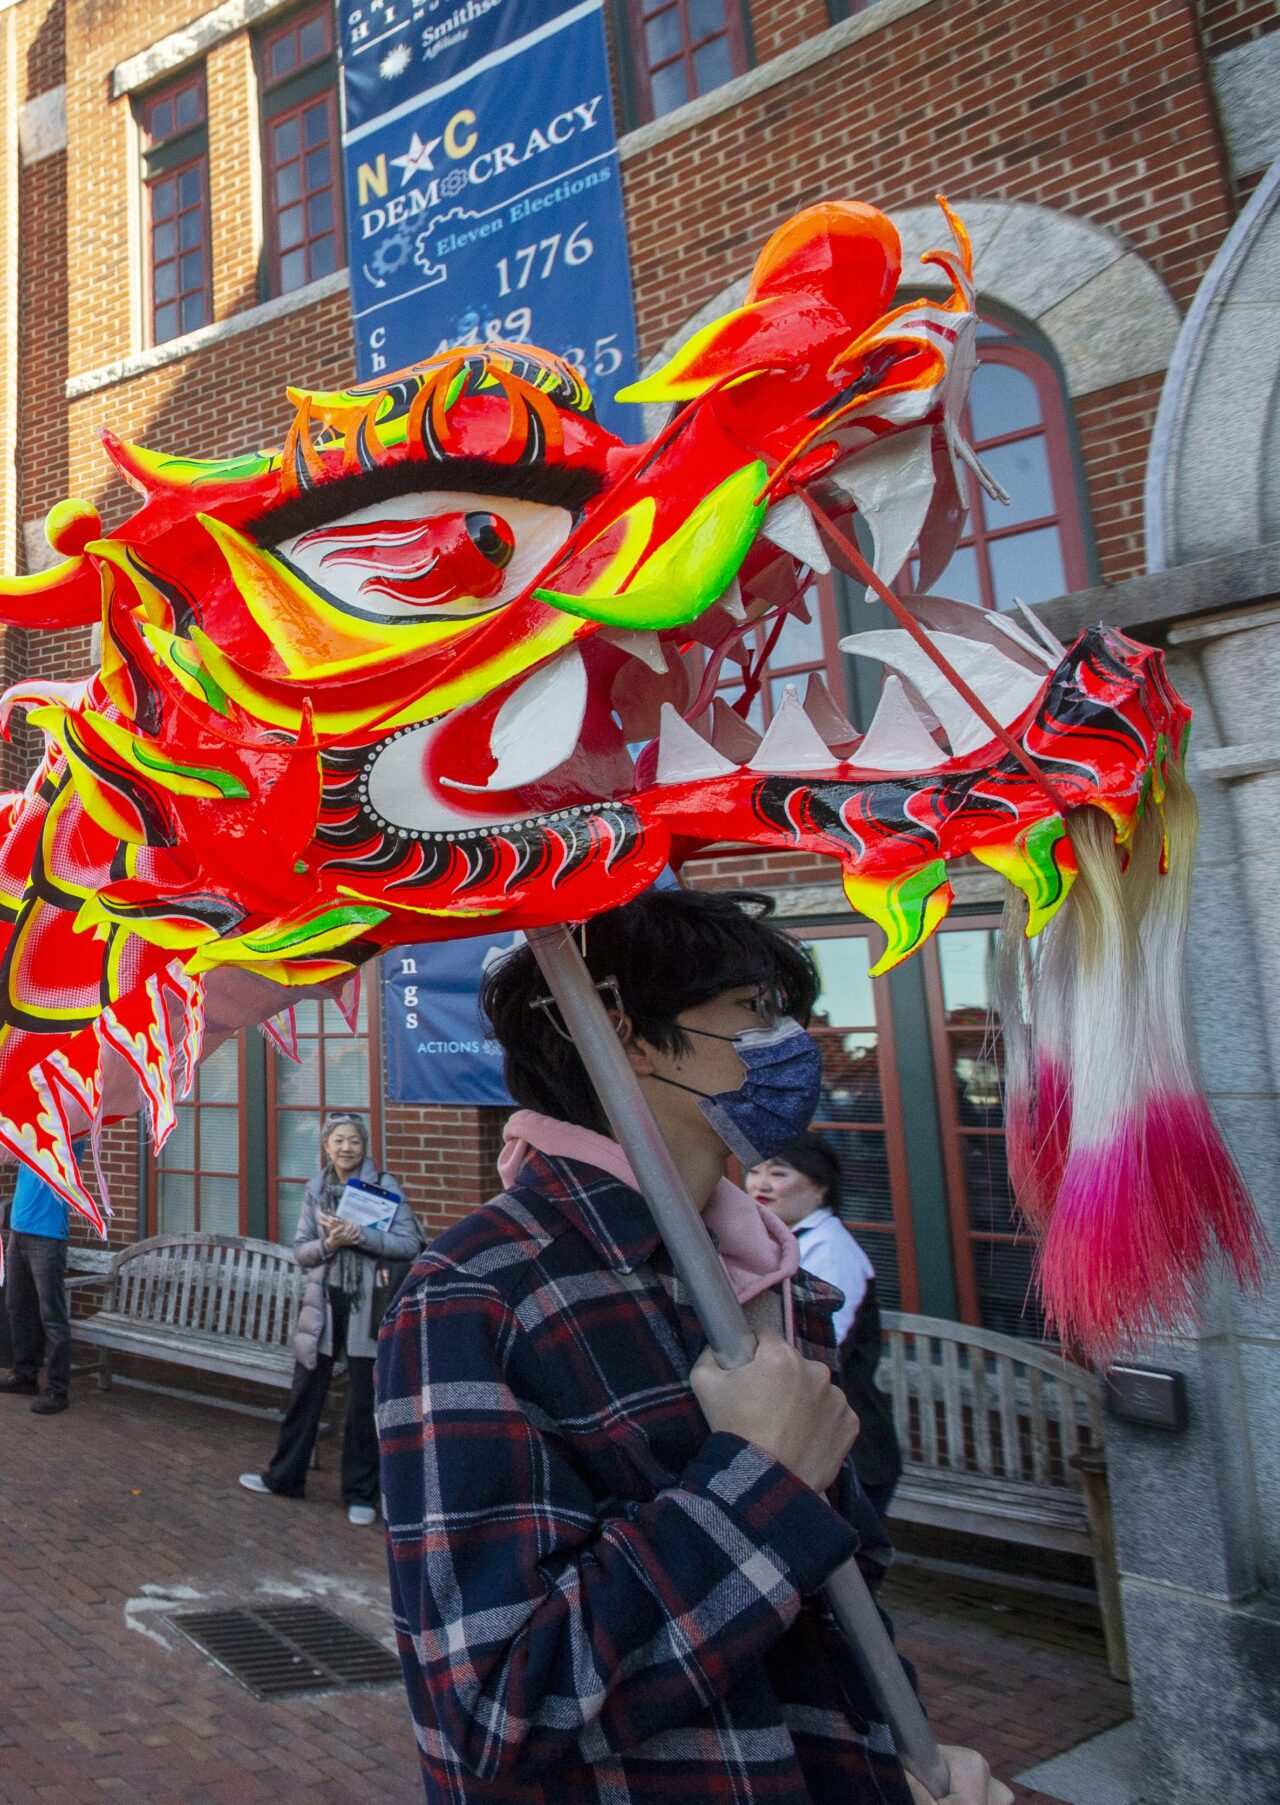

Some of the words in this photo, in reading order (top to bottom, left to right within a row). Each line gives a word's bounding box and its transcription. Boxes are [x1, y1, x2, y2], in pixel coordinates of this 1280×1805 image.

[436, 216, 503, 257] Eleven
[509, 166, 611, 224] Elections
[496, 220, 594, 298] 1776
[417, 1040, 480, 1054] ACTIONS
